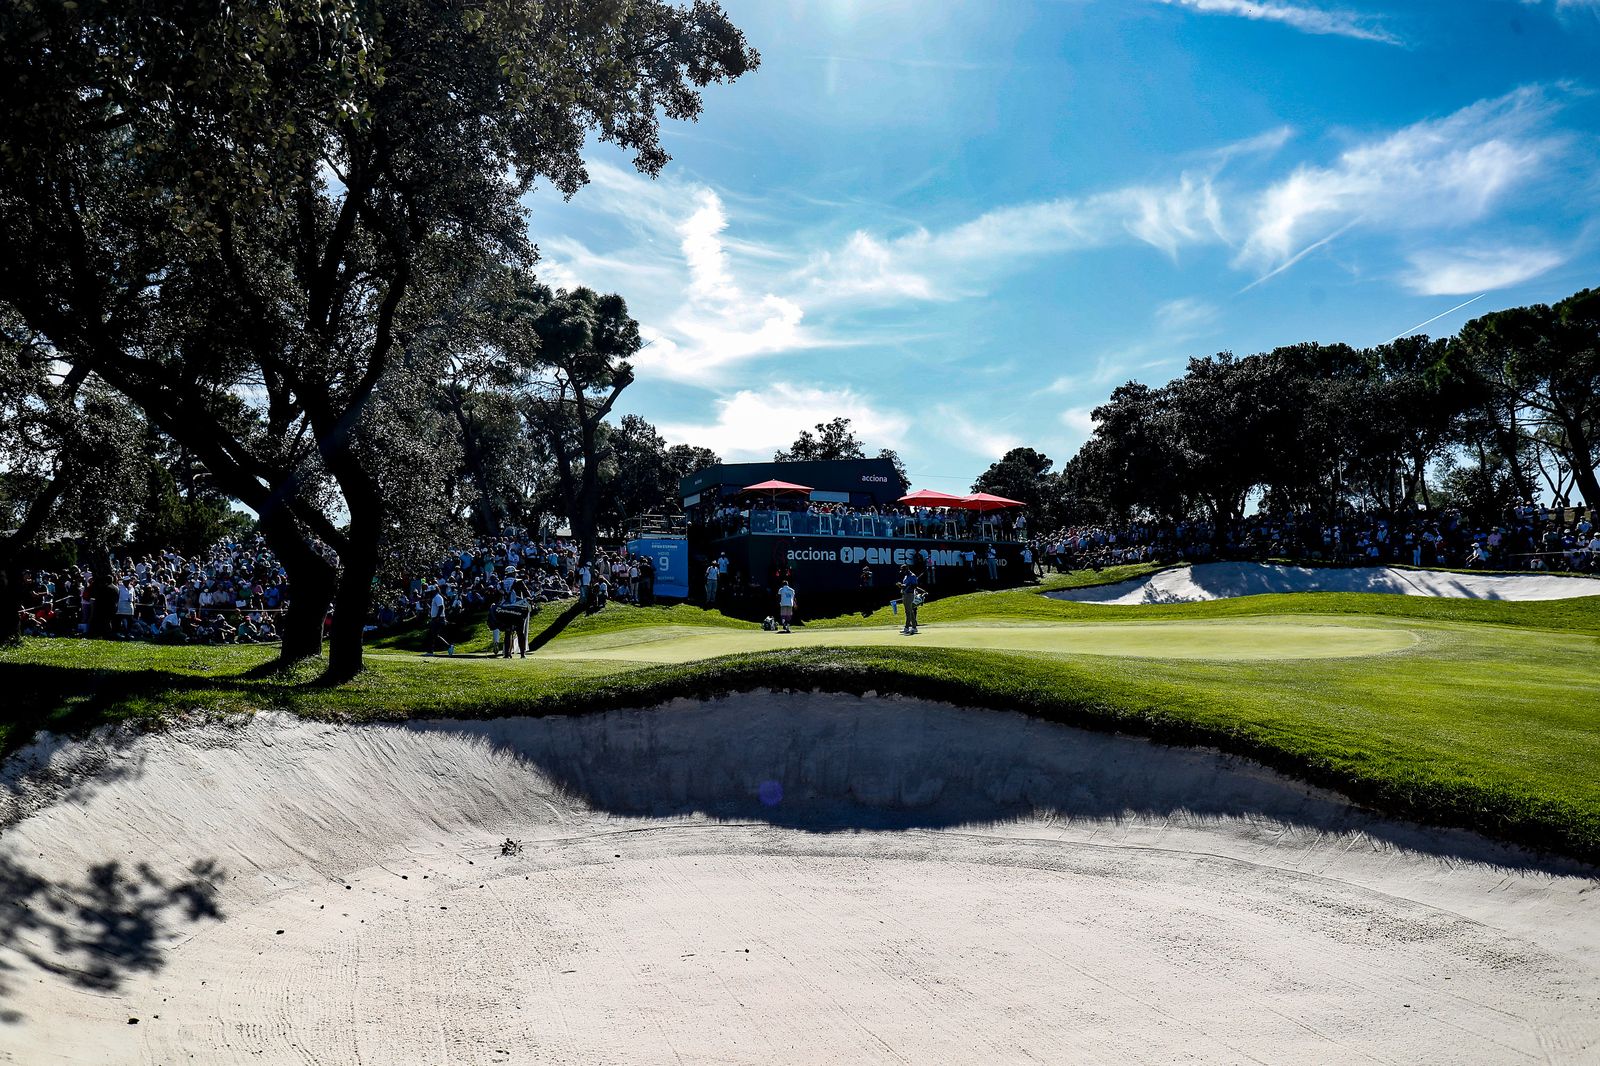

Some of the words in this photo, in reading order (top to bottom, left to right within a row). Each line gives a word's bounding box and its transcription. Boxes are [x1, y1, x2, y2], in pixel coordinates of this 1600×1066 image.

[861, 474, 888, 483] acciona
[786, 546, 837, 561] acciona
[840, 546, 892, 565] OPEN
[659, 556, 669, 572] 9
[976, 558, 1008, 567] MARID
